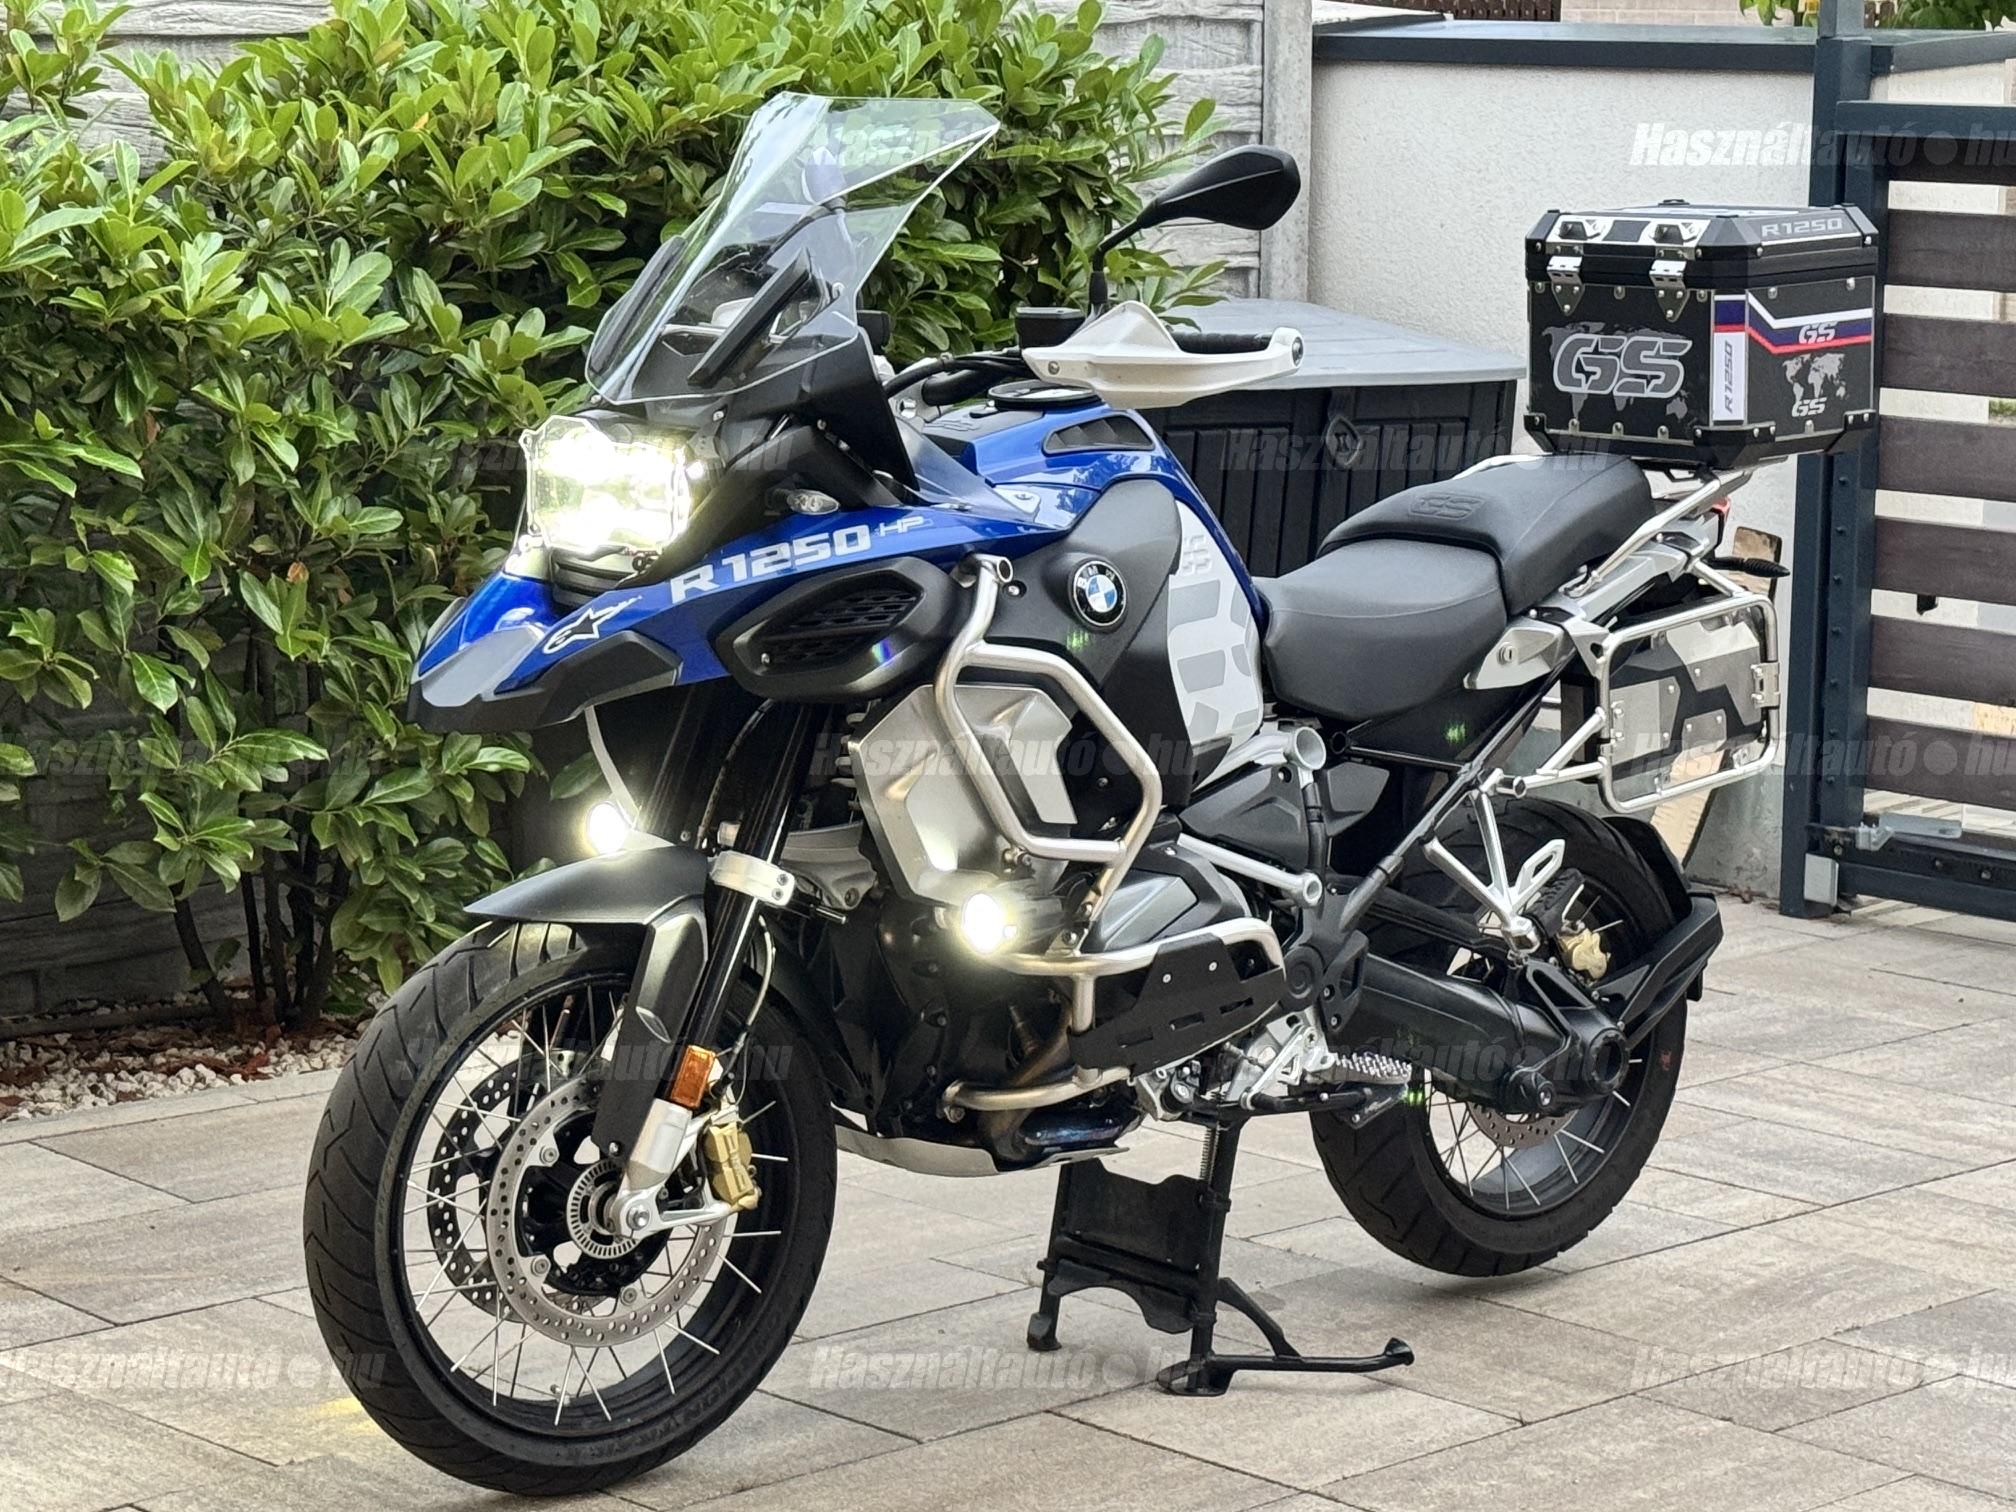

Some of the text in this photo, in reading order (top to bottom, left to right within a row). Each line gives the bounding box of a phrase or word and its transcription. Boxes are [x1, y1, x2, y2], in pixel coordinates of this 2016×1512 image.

[1761, 217, 1844, 238] R1250
[1797, 322, 1839, 345] GS
[1553, 332, 1693, 399] GS
[1724, 339, 1735, 415] R1250
[1791, 397, 1827, 417] GS
[1408, 491, 1485, 521] GS
[879, 515, 926, 538] HP
